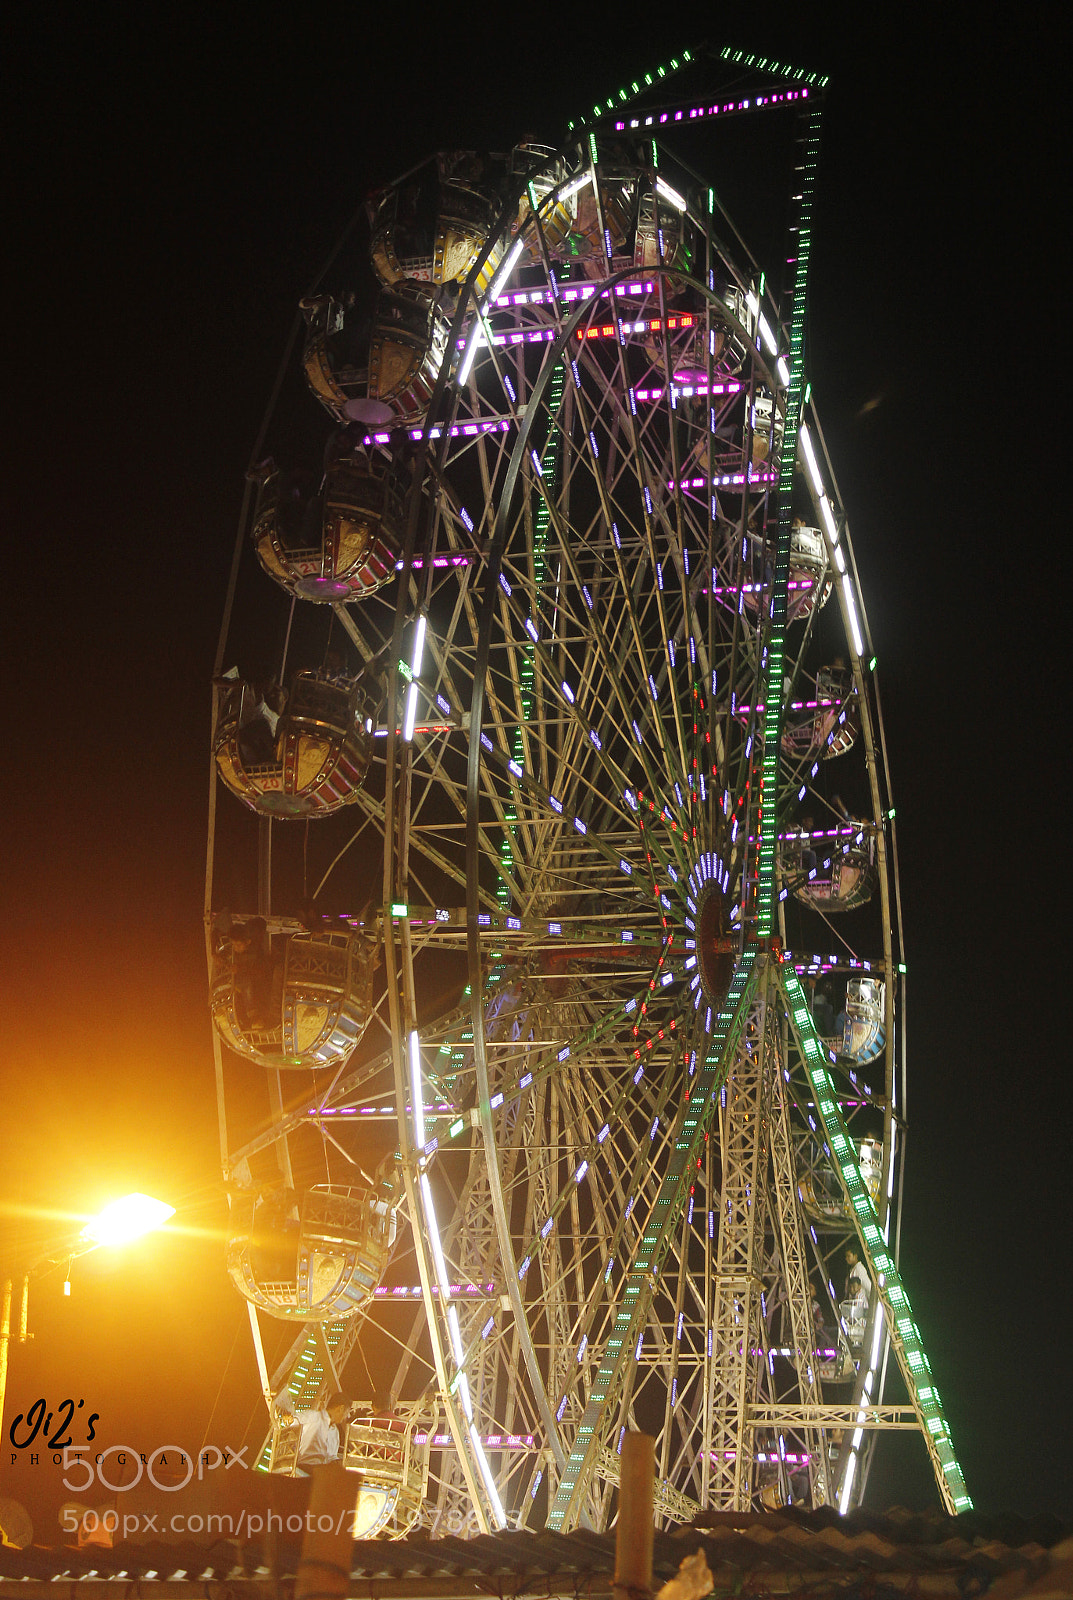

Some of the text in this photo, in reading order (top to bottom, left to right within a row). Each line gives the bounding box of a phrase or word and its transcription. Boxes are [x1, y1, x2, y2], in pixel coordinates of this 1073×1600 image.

[411, 270, 430, 281] 23
[299, 562, 317, 574] 21
[261, 778, 279, 790] 20
